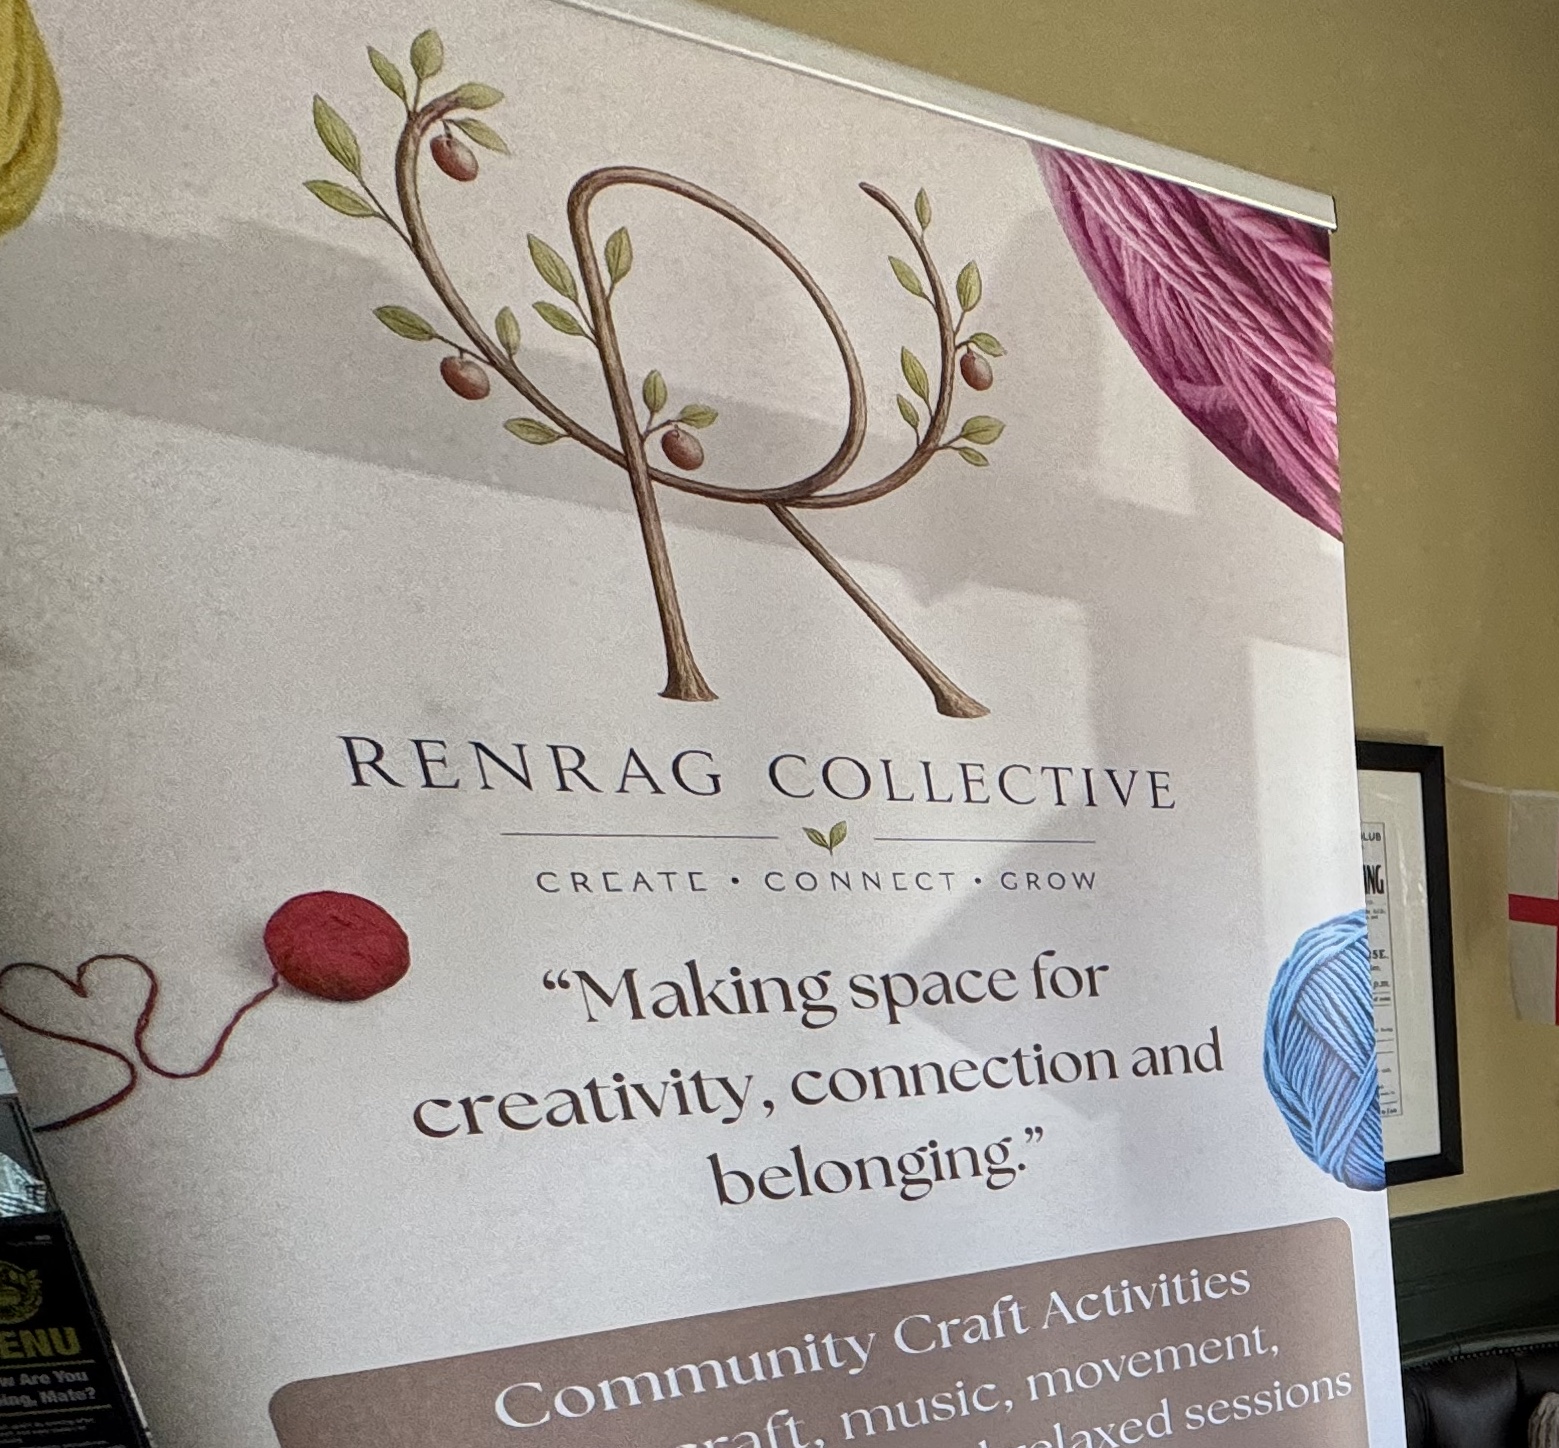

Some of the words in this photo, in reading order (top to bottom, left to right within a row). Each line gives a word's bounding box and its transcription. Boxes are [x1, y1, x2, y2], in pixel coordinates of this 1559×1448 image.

[337, 736, 722, 797] RENRAG
[768, 753, 1177, 810] COLLECTIVE
[1361, 832, 1382, 842] LUB
[536, 871, 709, 893] CREATE
[764, 871, 956, 892] CONNECT
[1000, 871, 1096, 891] GROW
[543, 960, 837, 1029] “Making
[849, 967, 1019, 1025] space
[1029, 950, 1109, 1000] for
[413, 1068, 776, 1138] creativity,
[791, 1043, 1119, 1106] connection
[1131, 1025, 1224, 1078] and
[706, 1126, 1044, 1206] belonging.”
[0, 1327, 81, 1358] ENU
[493, 1329, 876, 1430] Community
[893, 1296, 1029, 1358] Craft
[1040, 1267, 1251, 1331] Activities
[841, 1376, 1015, 1443] music,
[1027, 1325, 1281, 1399] movement,
[1185, 1374, 1353, 1430] sessions
